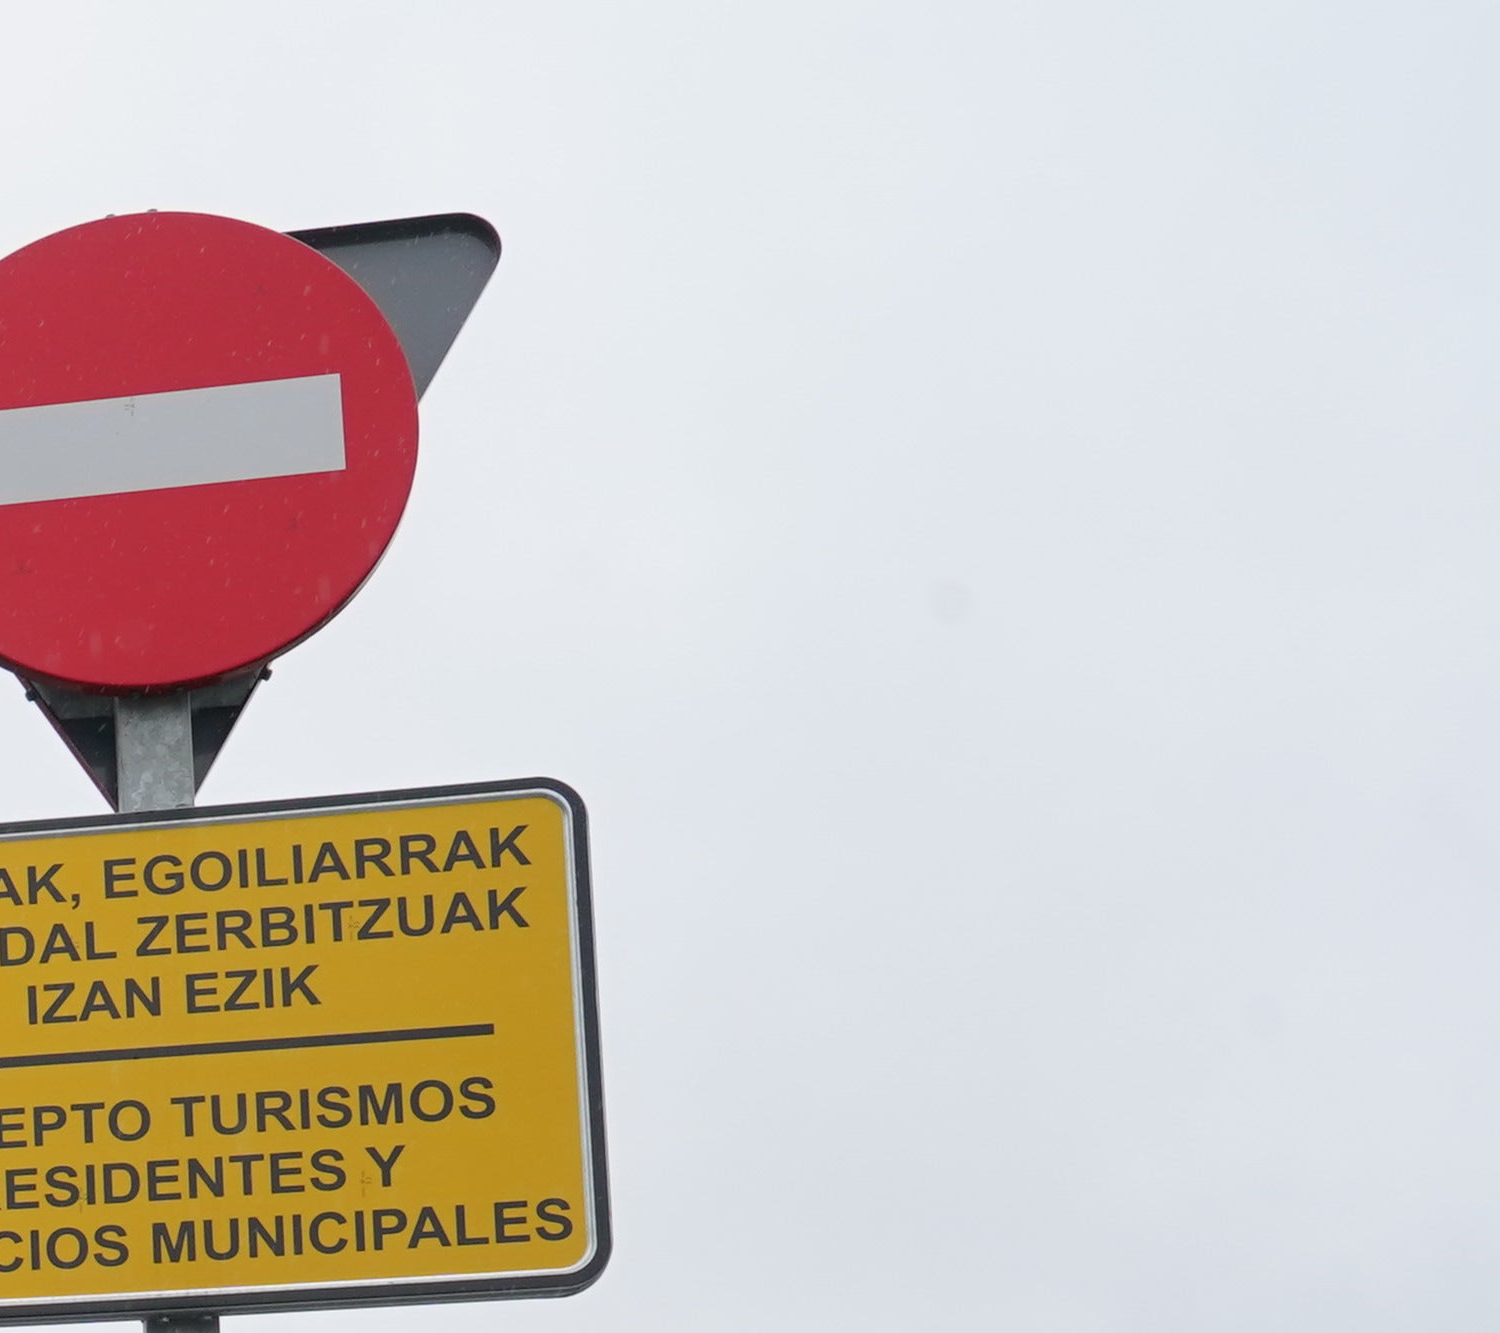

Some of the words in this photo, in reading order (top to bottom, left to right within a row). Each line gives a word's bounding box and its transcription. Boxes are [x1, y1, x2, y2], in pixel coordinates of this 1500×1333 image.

[103, 824, 532, 899] EGOILIARRAK
[136, 886, 531, 957] ZERBITZUAK
[26, 976, 161, 1026] IZAN
[184, 964, 322, 1015] EZIK
[171, 1075, 497, 1138] TURISMOS
[365, 1145, 406, 1188] Y
[151, 1197, 574, 1264] MUNICIPALES
